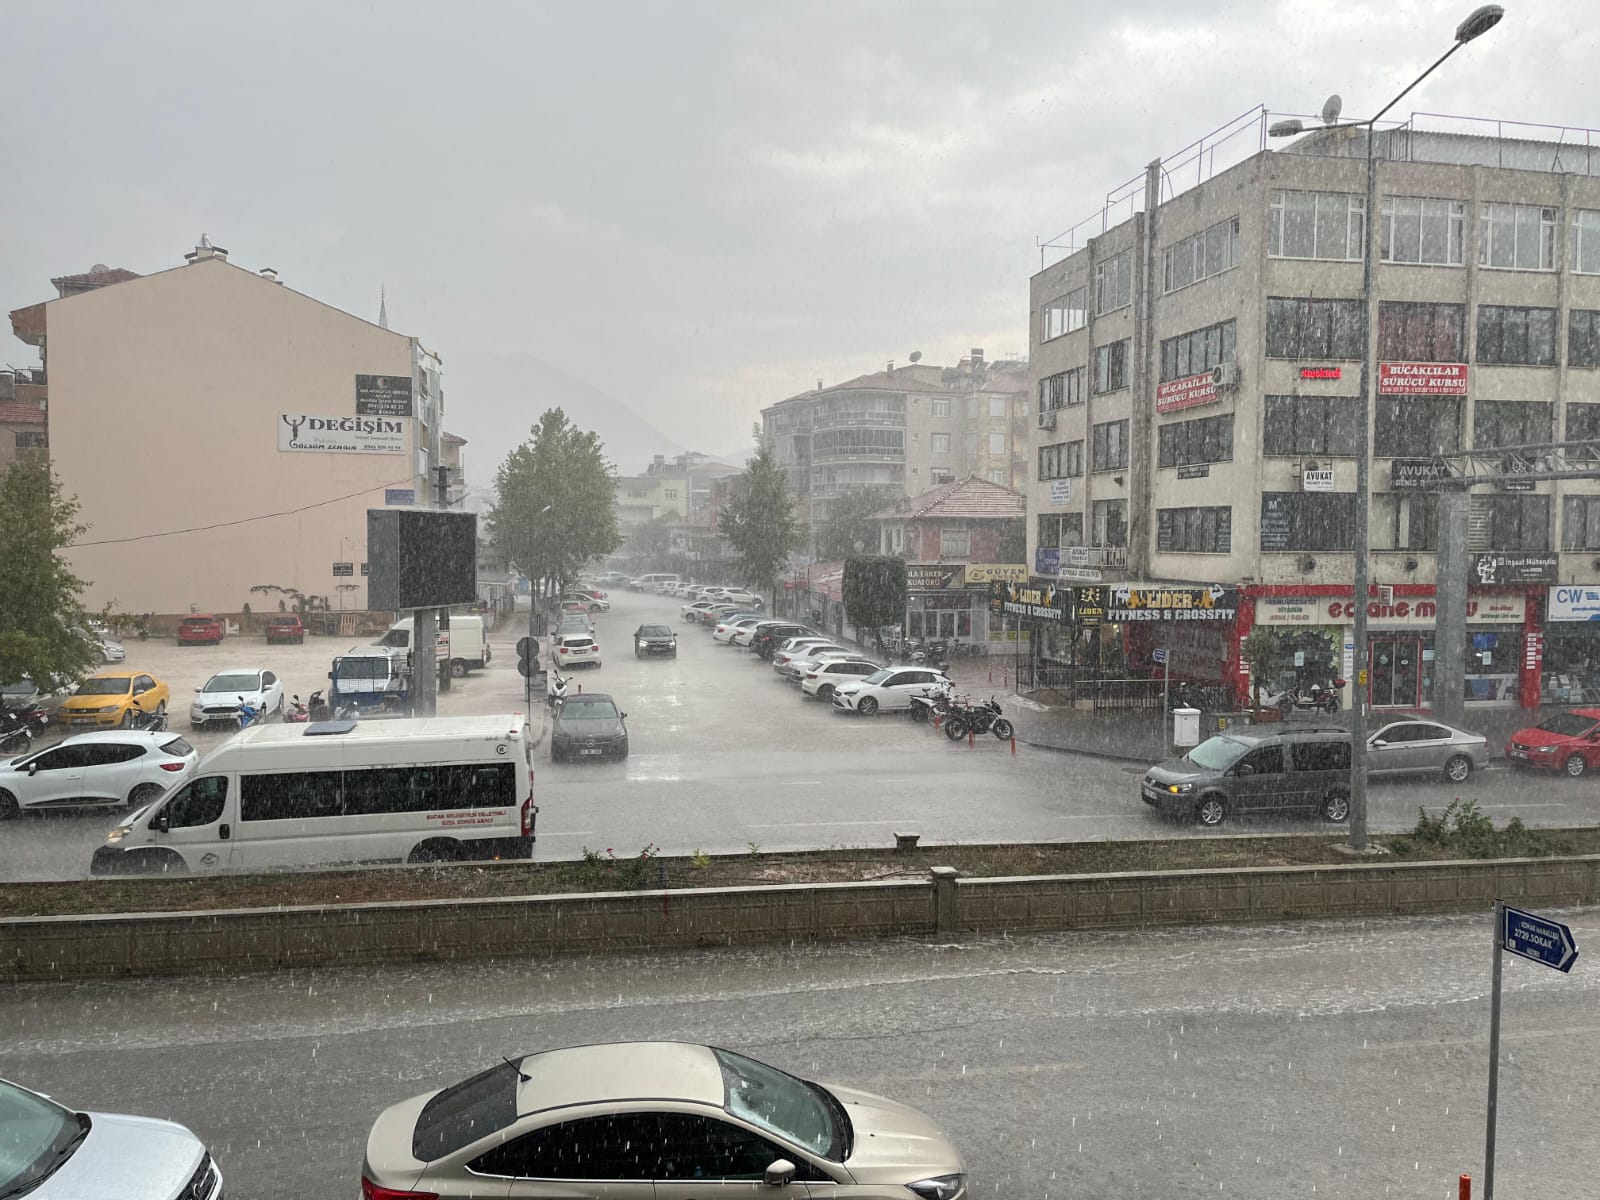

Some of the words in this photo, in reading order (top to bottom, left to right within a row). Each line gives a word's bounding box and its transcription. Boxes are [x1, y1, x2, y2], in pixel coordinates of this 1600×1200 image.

[1390, 366, 1460, 375] BUCAKLILAR
[1429, 379, 1466, 387] KURSU
[308, 416, 403, 434] DEĞİŞİM
[1306, 471, 1333, 481] AVUKAT
[1557, 588, 1584, 604] CW
[1107, 609, 1160, 620] FITNESS
[1163, 609, 1172, 620] &
[1175, 608, 1235, 620] CROSSFIT
